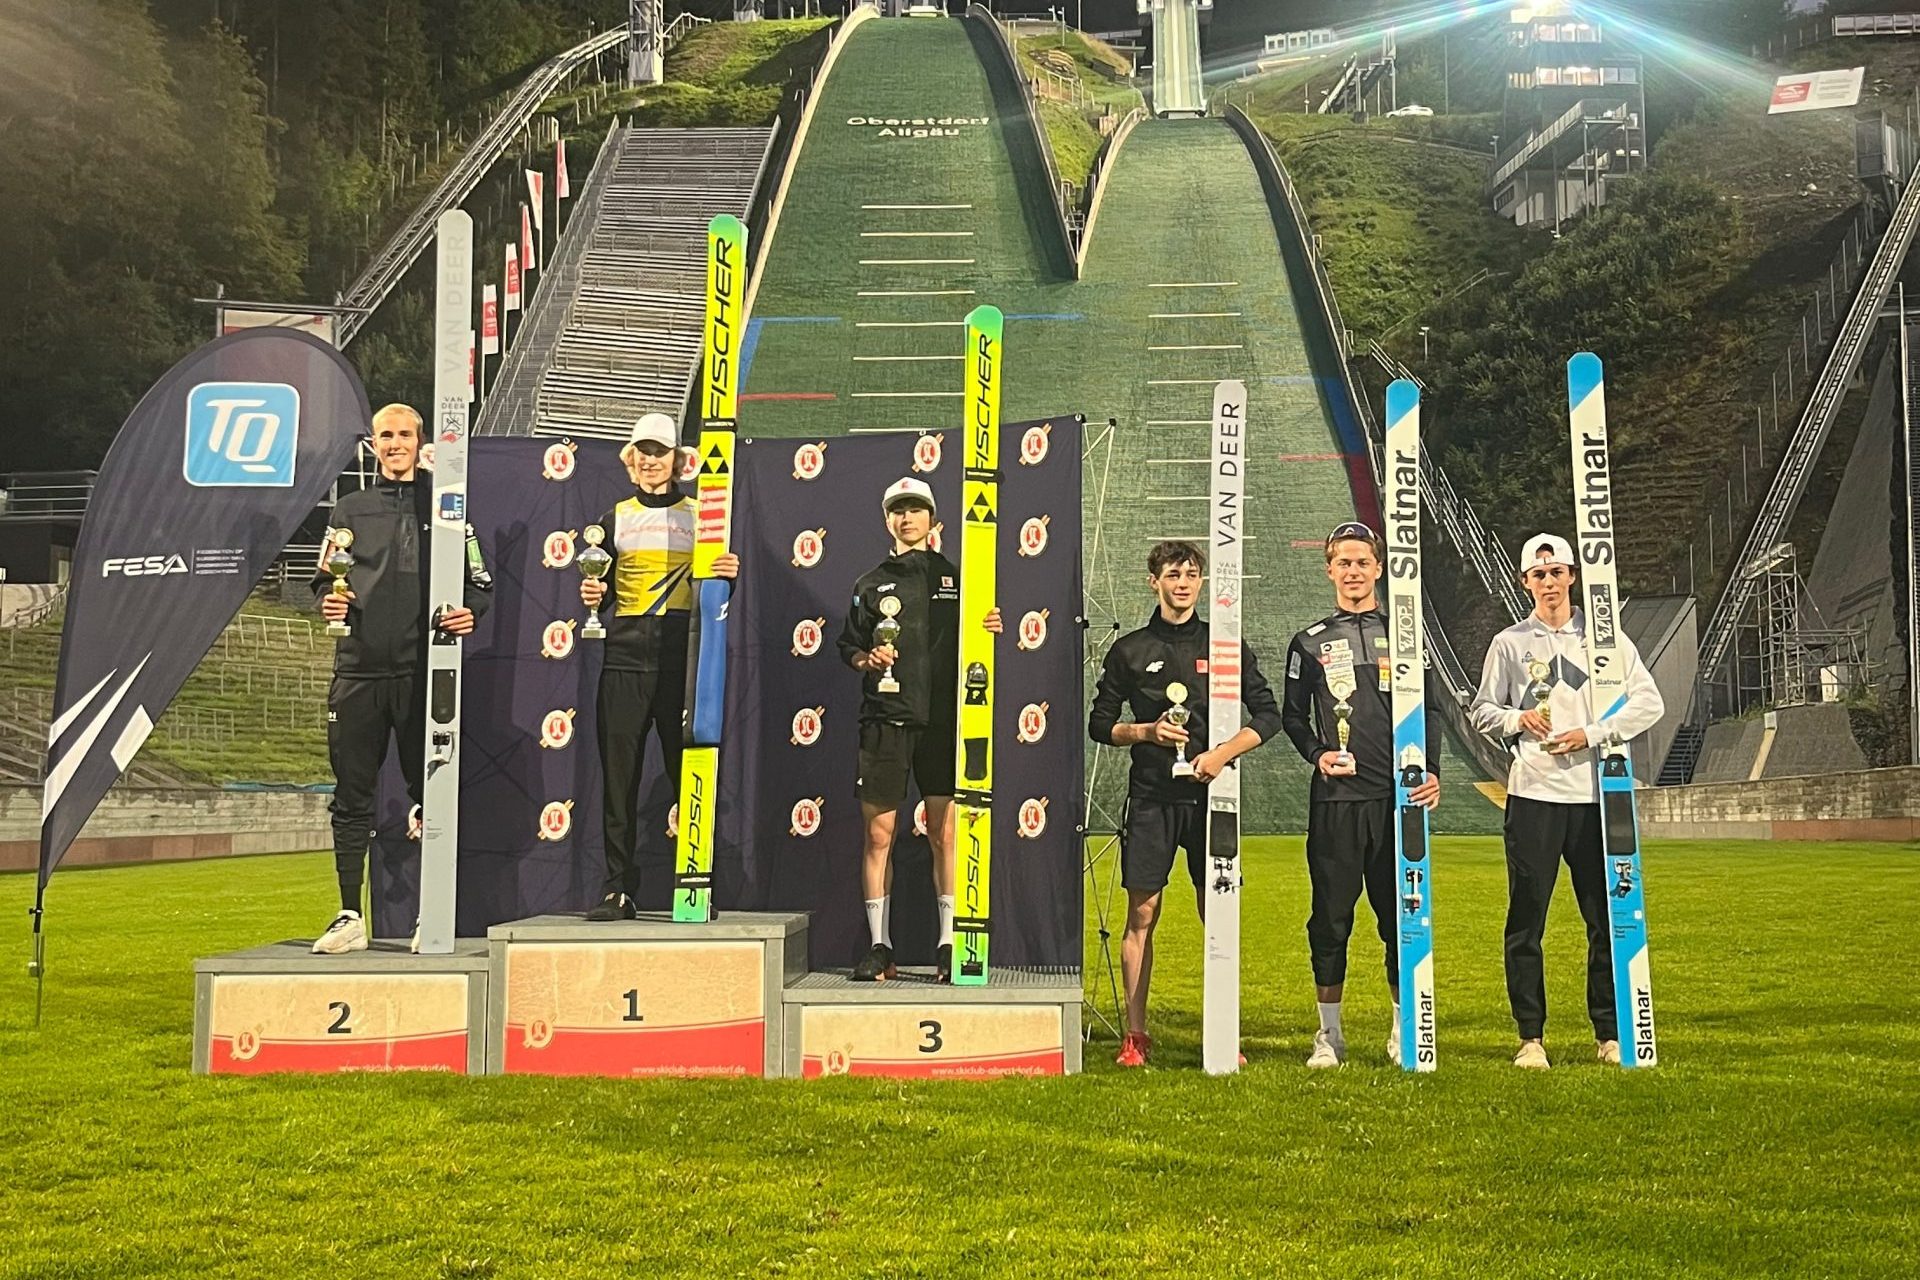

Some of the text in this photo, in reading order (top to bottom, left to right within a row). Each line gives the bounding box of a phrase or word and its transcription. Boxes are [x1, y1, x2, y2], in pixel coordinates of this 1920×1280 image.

[847, 116, 990, 126] Oberstdorf
[878, 128, 960, 138] Allgäu
[710, 237, 733, 418] FISCHER
[205, 398, 281, 474] TQ
[975, 333, 993, 469] FISCHER
[1217, 403, 1240, 547] VAN DEER
[1580, 432, 1613, 565] Slatnar
[1389, 449, 1418, 580] Slatnar
[102, 553, 189, 578] FESA
[1216, 567, 1239, 575] DEER
[327, 1001, 352, 1034] 2
[622, 989, 644, 1021] 1
[918, 1020, 943, 1053] 3
[1418, 991, 1434, 1063] Slatnar
[1636, 988, 1654, 1060] Slatnar
